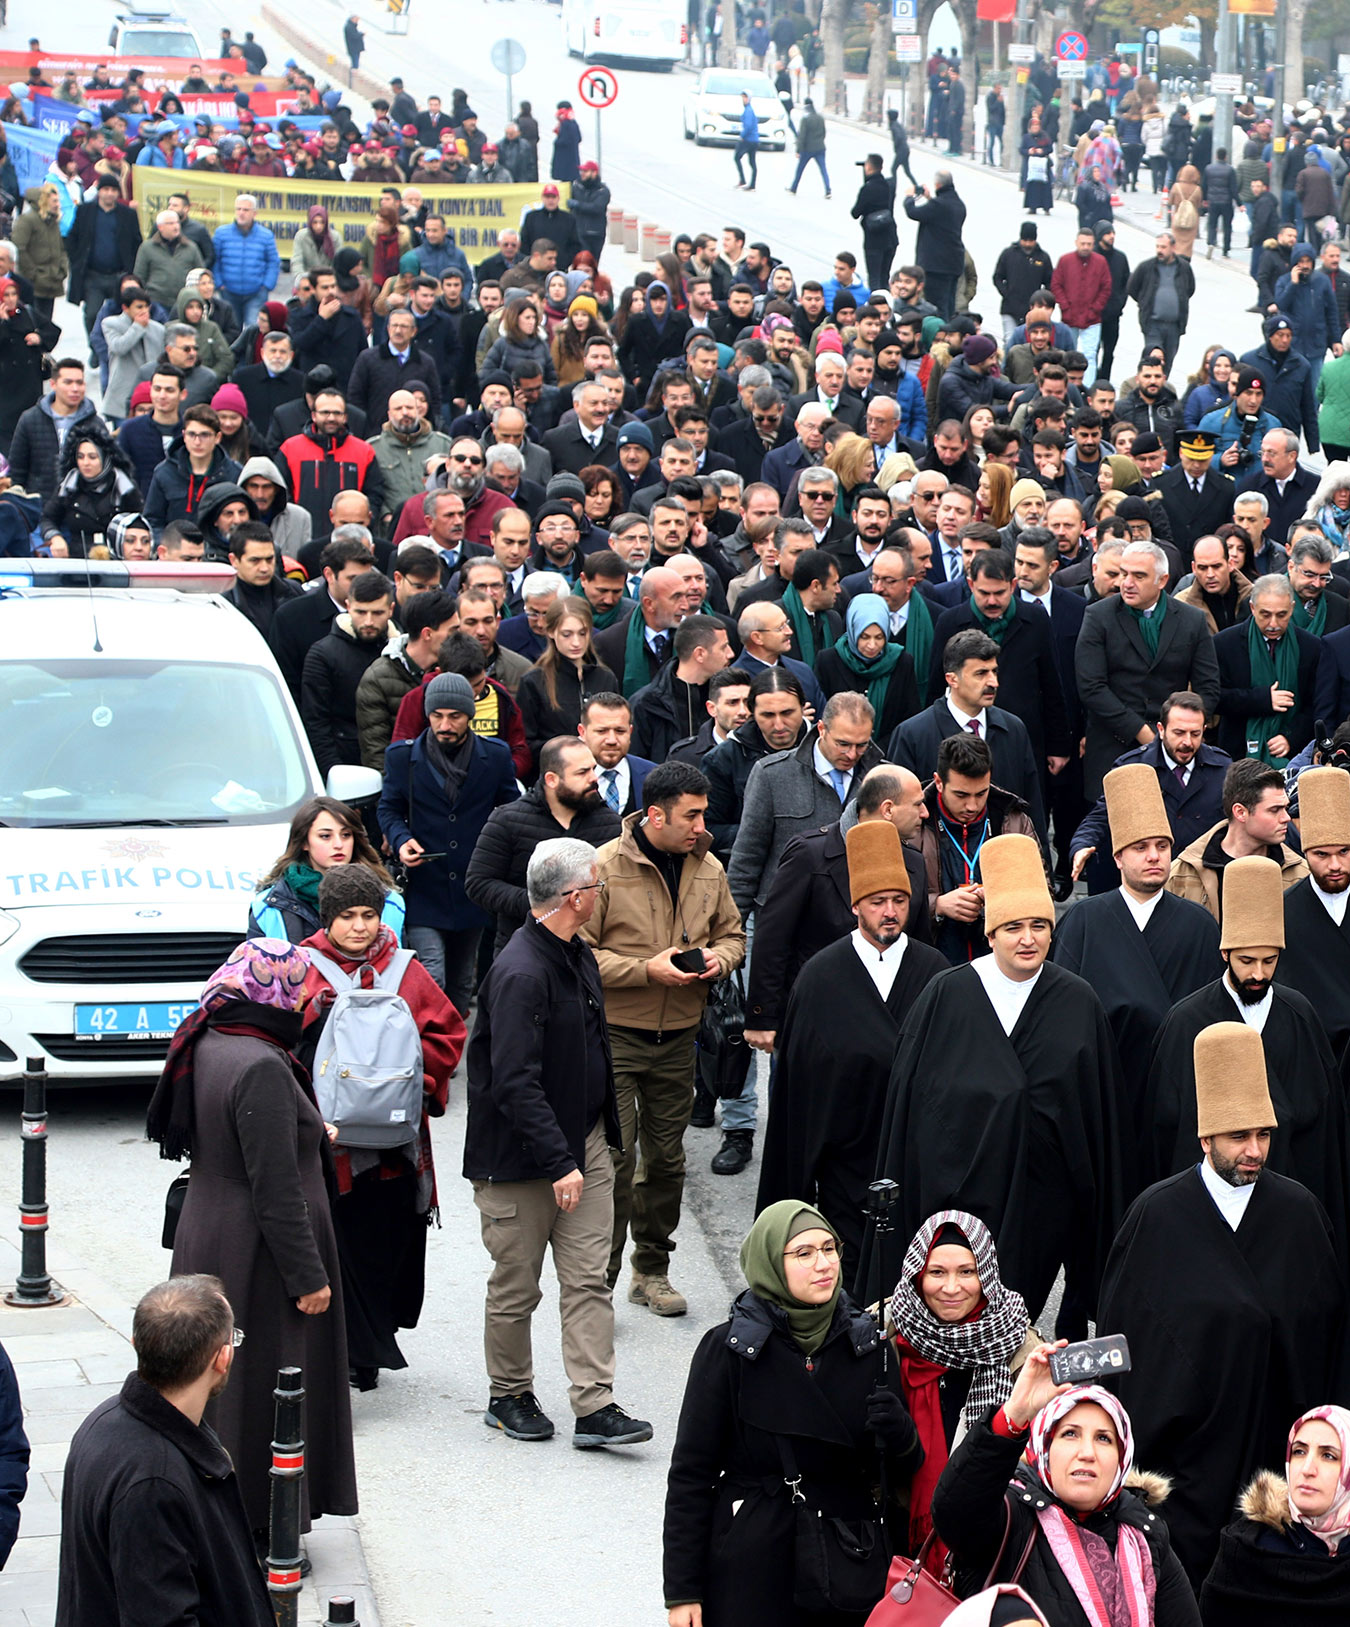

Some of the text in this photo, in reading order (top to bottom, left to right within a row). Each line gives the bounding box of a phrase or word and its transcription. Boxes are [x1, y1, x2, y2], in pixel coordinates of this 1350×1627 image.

[438, 198, 506, 217] KONYA'DAN.
[459, 224, 479, 246] BİR
[467, 719, 493, 731] LACK
[6, 863, 261, 896] TRAFİK POLİS
[90, 1007, 118, 1030] 42
[135, 1006, 150, 1030] A
[127, 1032, 151, 1040] AKER
